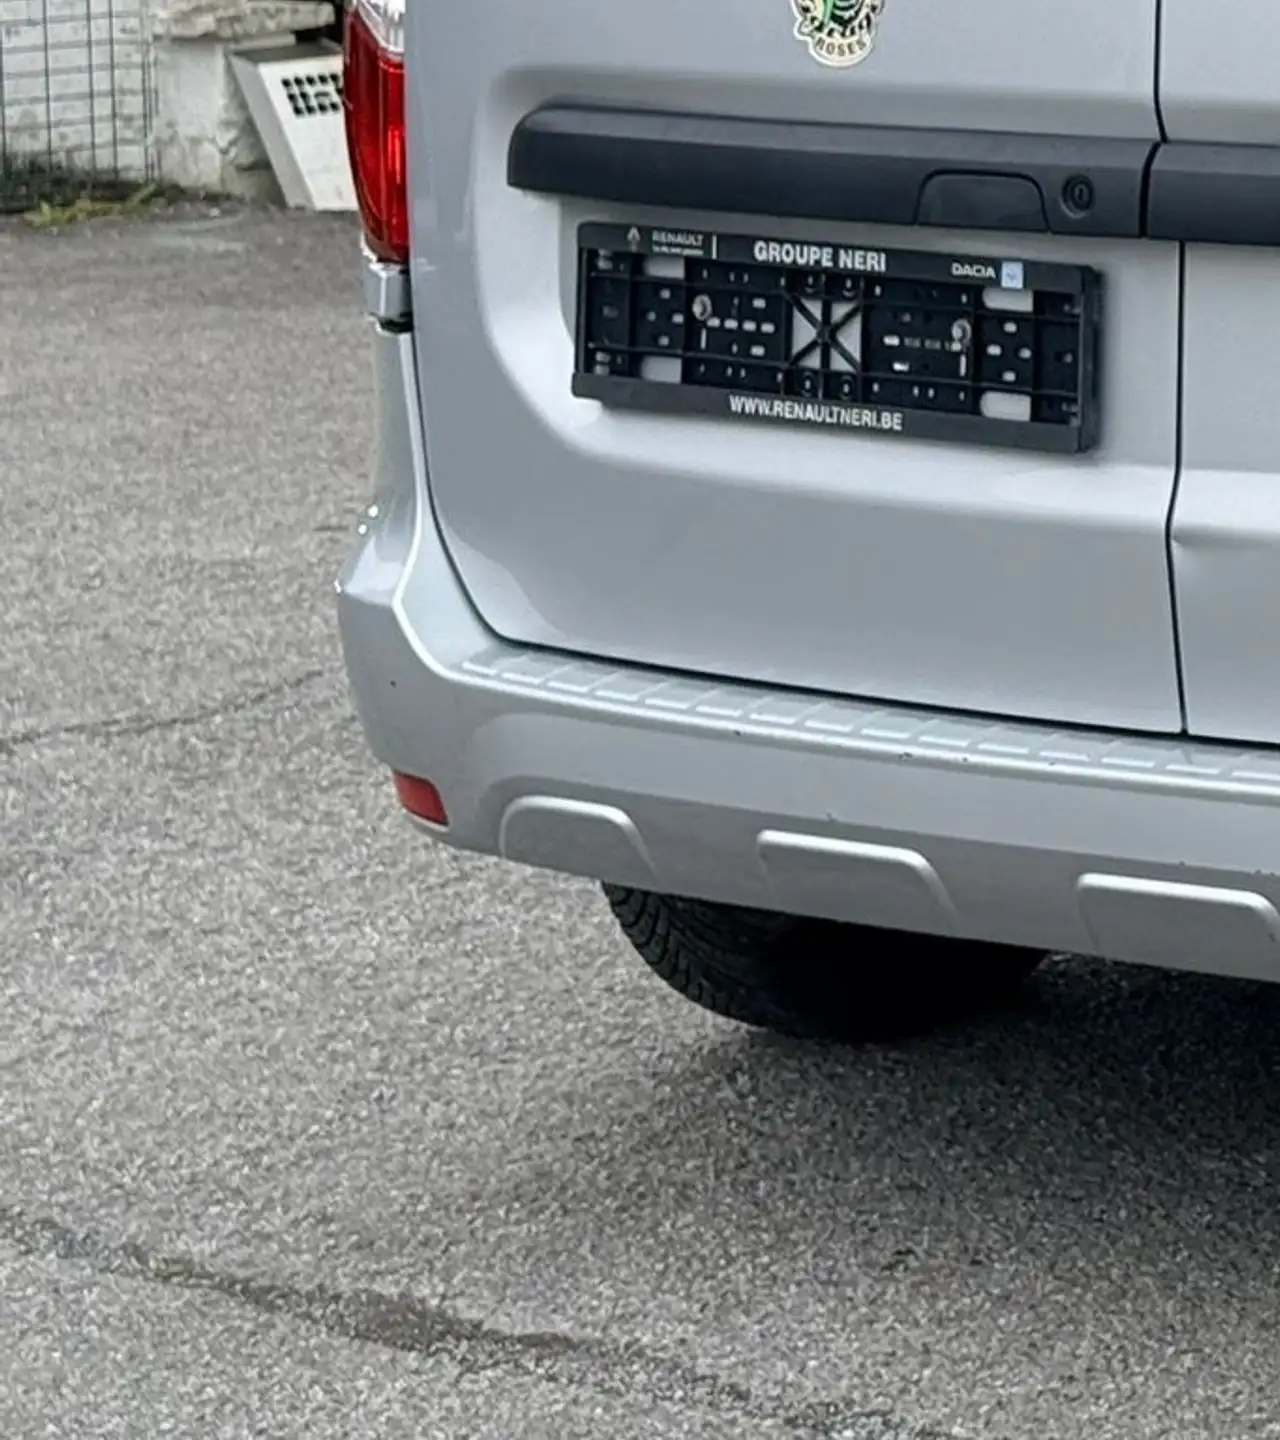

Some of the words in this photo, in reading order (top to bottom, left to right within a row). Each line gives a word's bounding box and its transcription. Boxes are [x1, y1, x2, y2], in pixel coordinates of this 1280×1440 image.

[753, 240, 834, 268] GROUPE
[839, 248, 887, 273] NERI
[951, 262, 997, 279] DACIA
[729, 394, 903, 431] WWW.RENAULTNERI.BE
